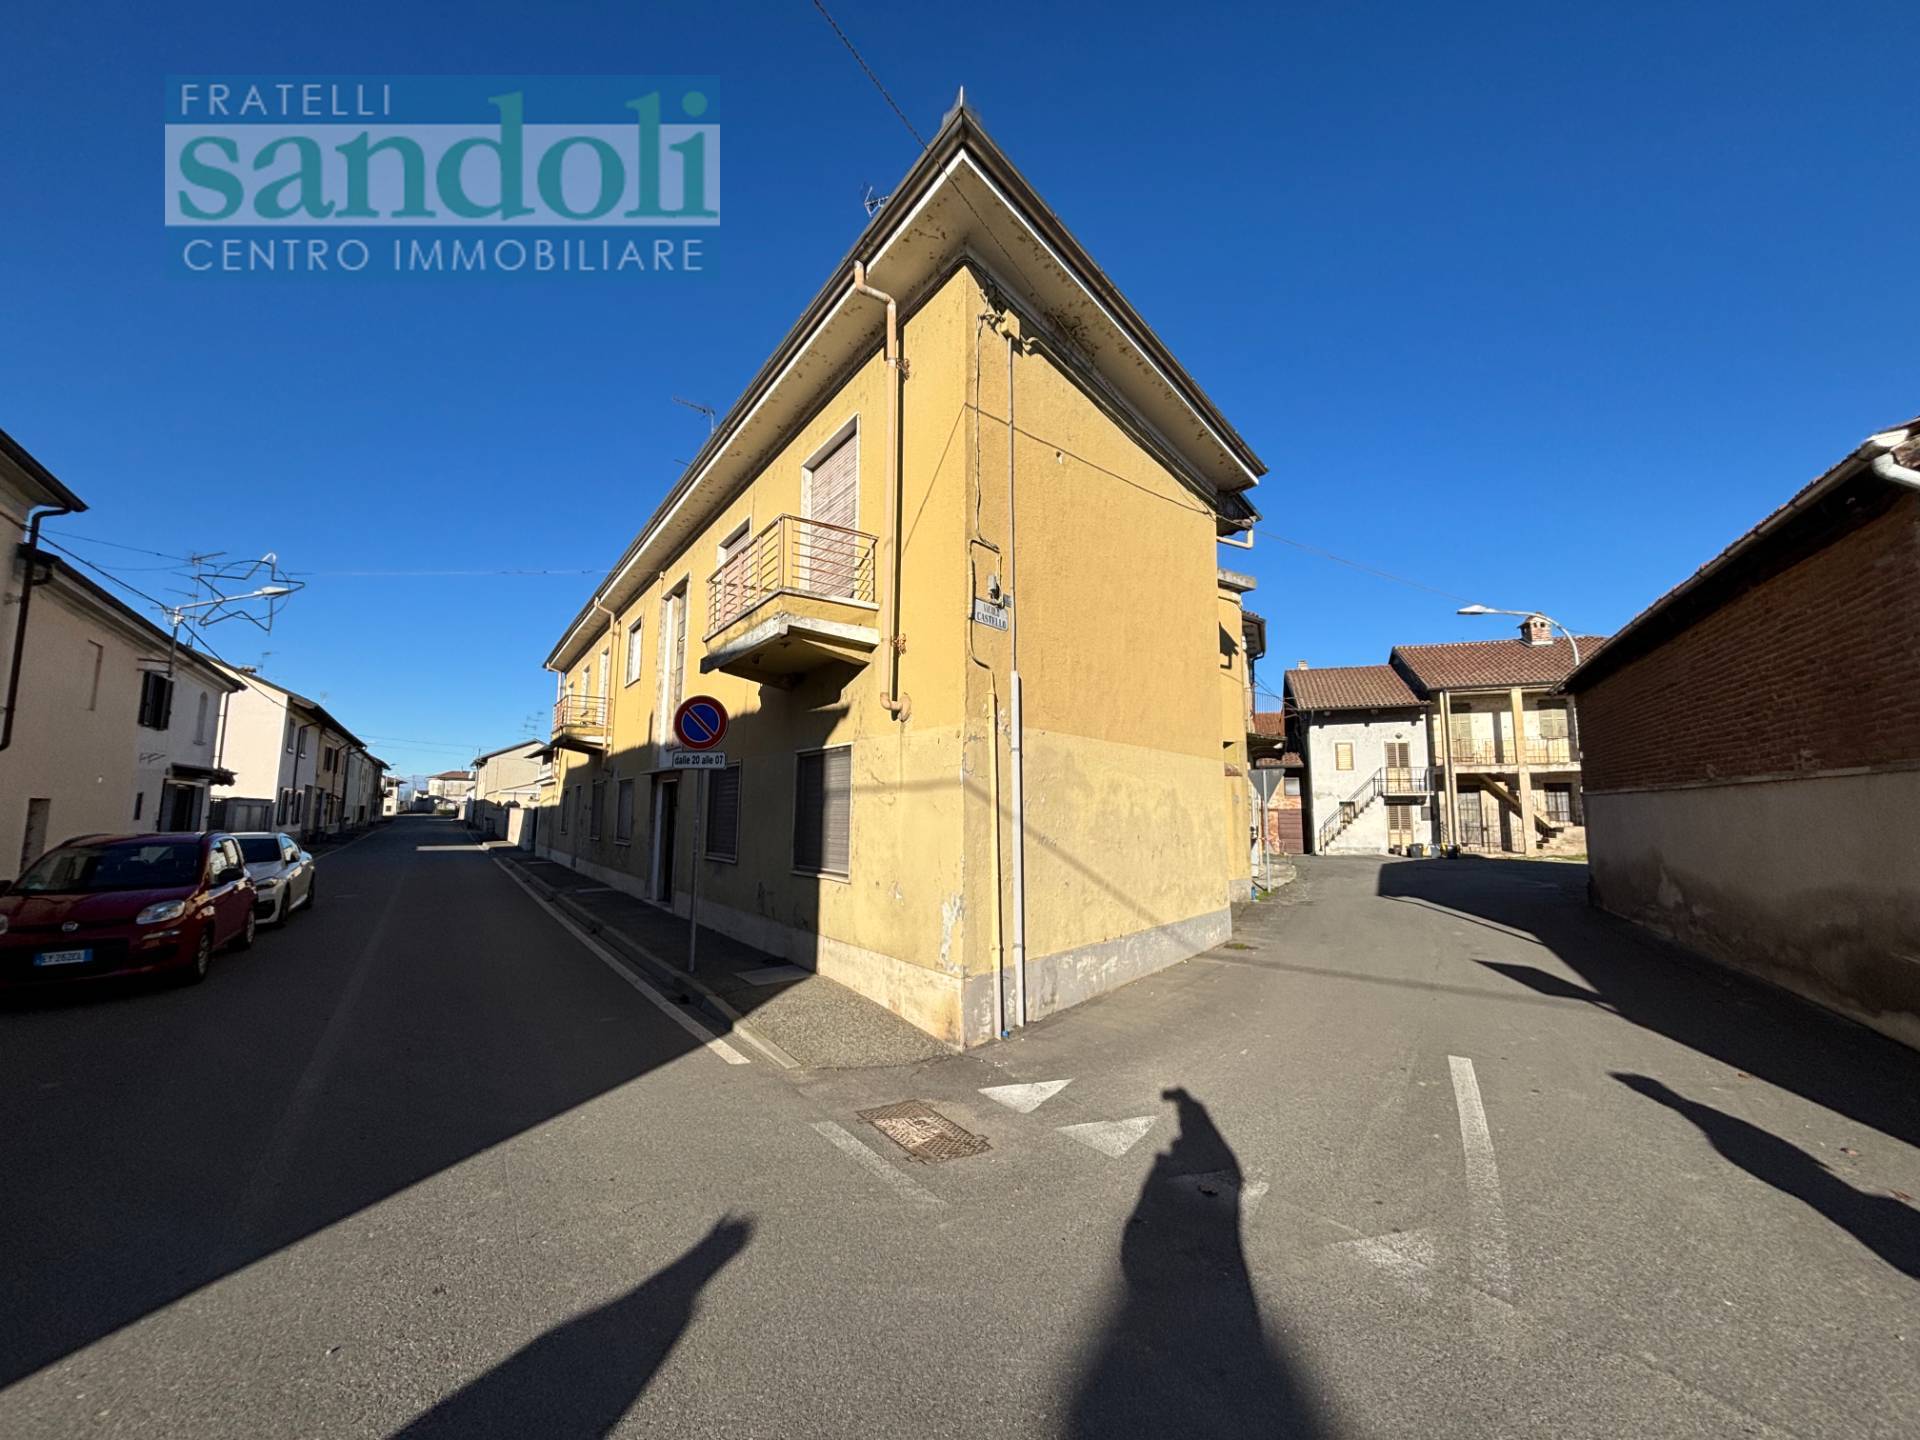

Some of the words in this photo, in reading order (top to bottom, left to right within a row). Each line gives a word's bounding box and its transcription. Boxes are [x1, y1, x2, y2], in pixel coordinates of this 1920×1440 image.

[675, 755, 690, 765] dalle
[692, 755, 700, 765] 20
[702, 755, 713, 765] alle
[715, 755, 723, 765] 07
